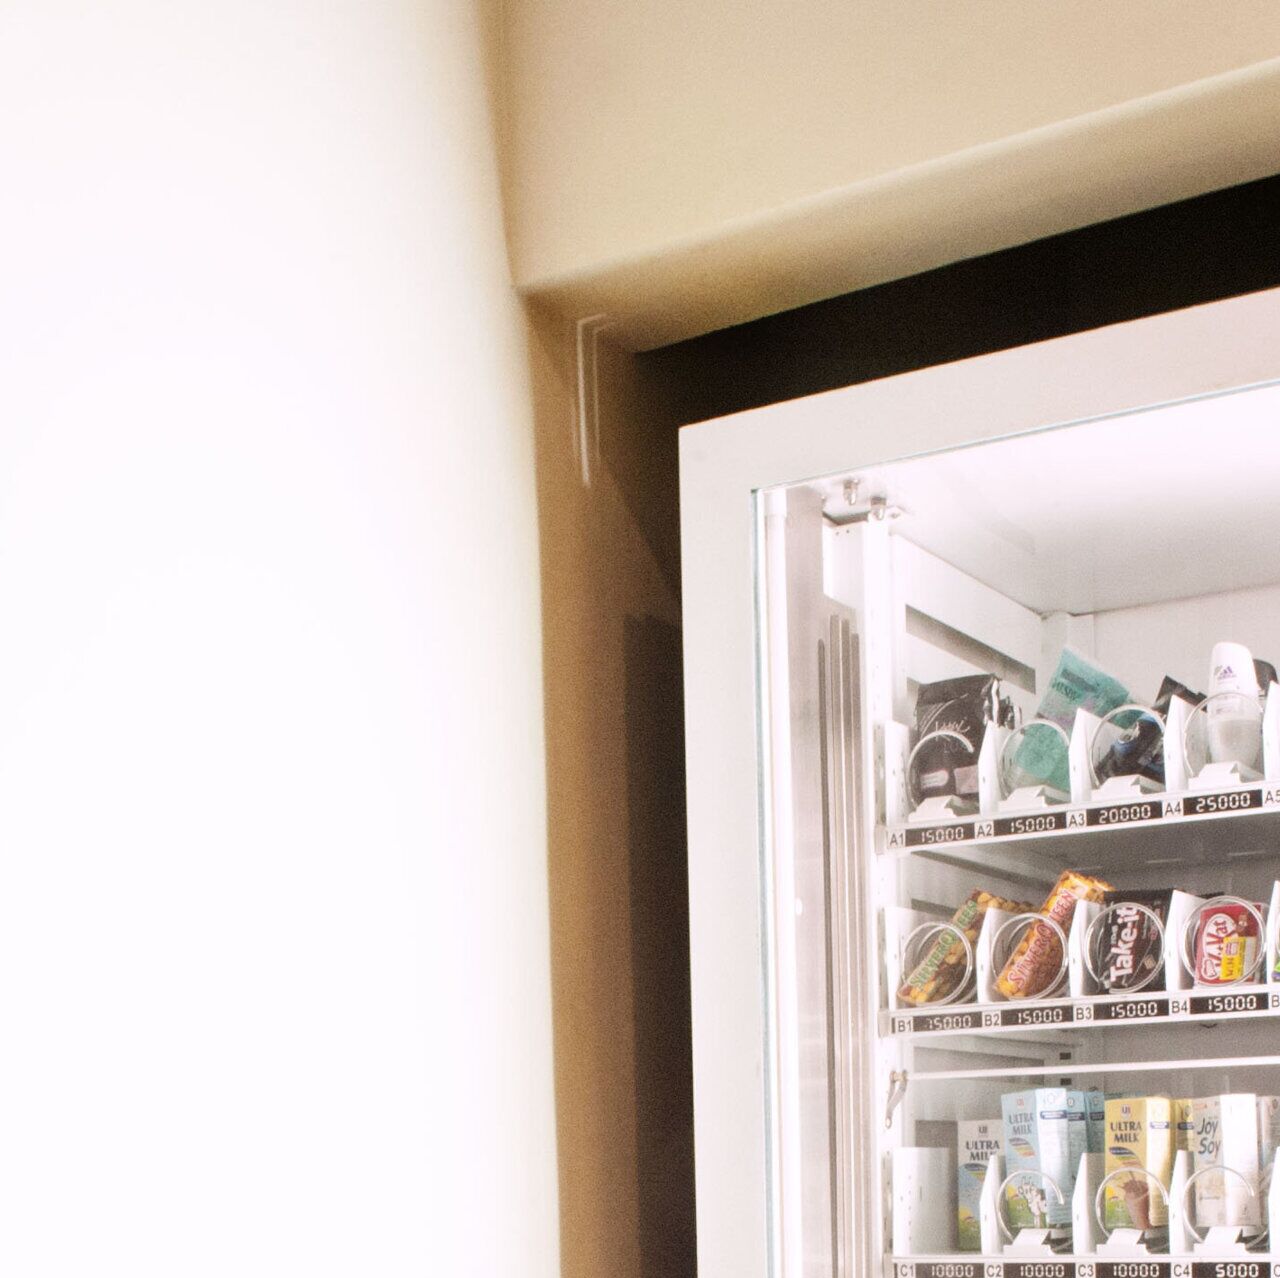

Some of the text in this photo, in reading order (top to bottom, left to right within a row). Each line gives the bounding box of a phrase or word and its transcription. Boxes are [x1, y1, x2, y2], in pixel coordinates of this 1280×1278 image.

[1164, 793, 1251, 816] A4 25000
[1068, 804, 1152, 826] A3 20000
[976, 816, 1056, 838] A2 15000
[889, 826, 965, 846] A1 15000
[1110, 905, 1139, 983] Take-it
[1075, 1001, 1159, 1021] B3 15000
[1171, 995, 1258, 1014] B4 15000
[897, 1019, 912, 1033] B1
[984, 1008, 1063, 1027] B2 15000
[1008, 1112, 1034, 1125] ULTRA
[1110, 1121, 1142, 1132] ULTRA
[1197, 1117, 1219, 1136] Joy
[965, 1140, 1001, 1151] ULTRA
[1113, 1132, 1139, 1143] MILK
[1197, 1138, 1221, 1155] Soy
[900, 1264, 974, 1278] C1 10000
[986, 1264, 1065, 1278] C2 10000
[1078, 1263, 1160, 1278] C3 10000
[1173, 1263, 1259, 1278] C4 5000
